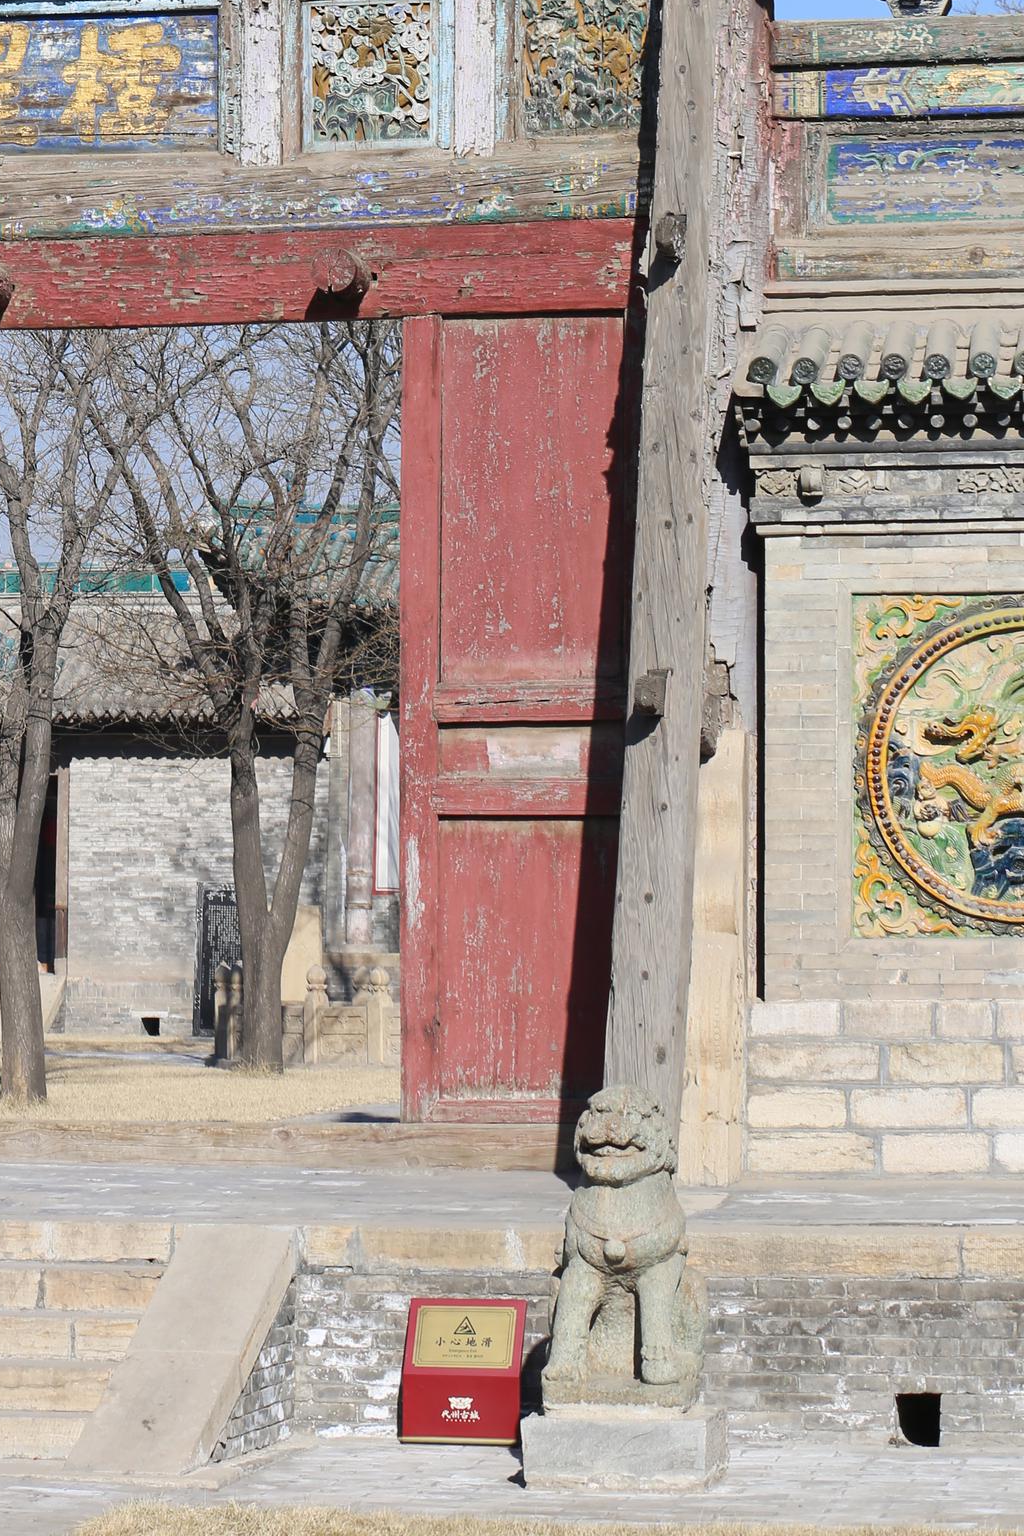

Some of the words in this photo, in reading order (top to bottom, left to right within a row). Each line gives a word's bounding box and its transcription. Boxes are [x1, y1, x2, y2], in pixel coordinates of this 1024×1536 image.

[435, 1336, 493, 1348] 小心地滑
[441, 1409, 481, 1420] 代州古城
